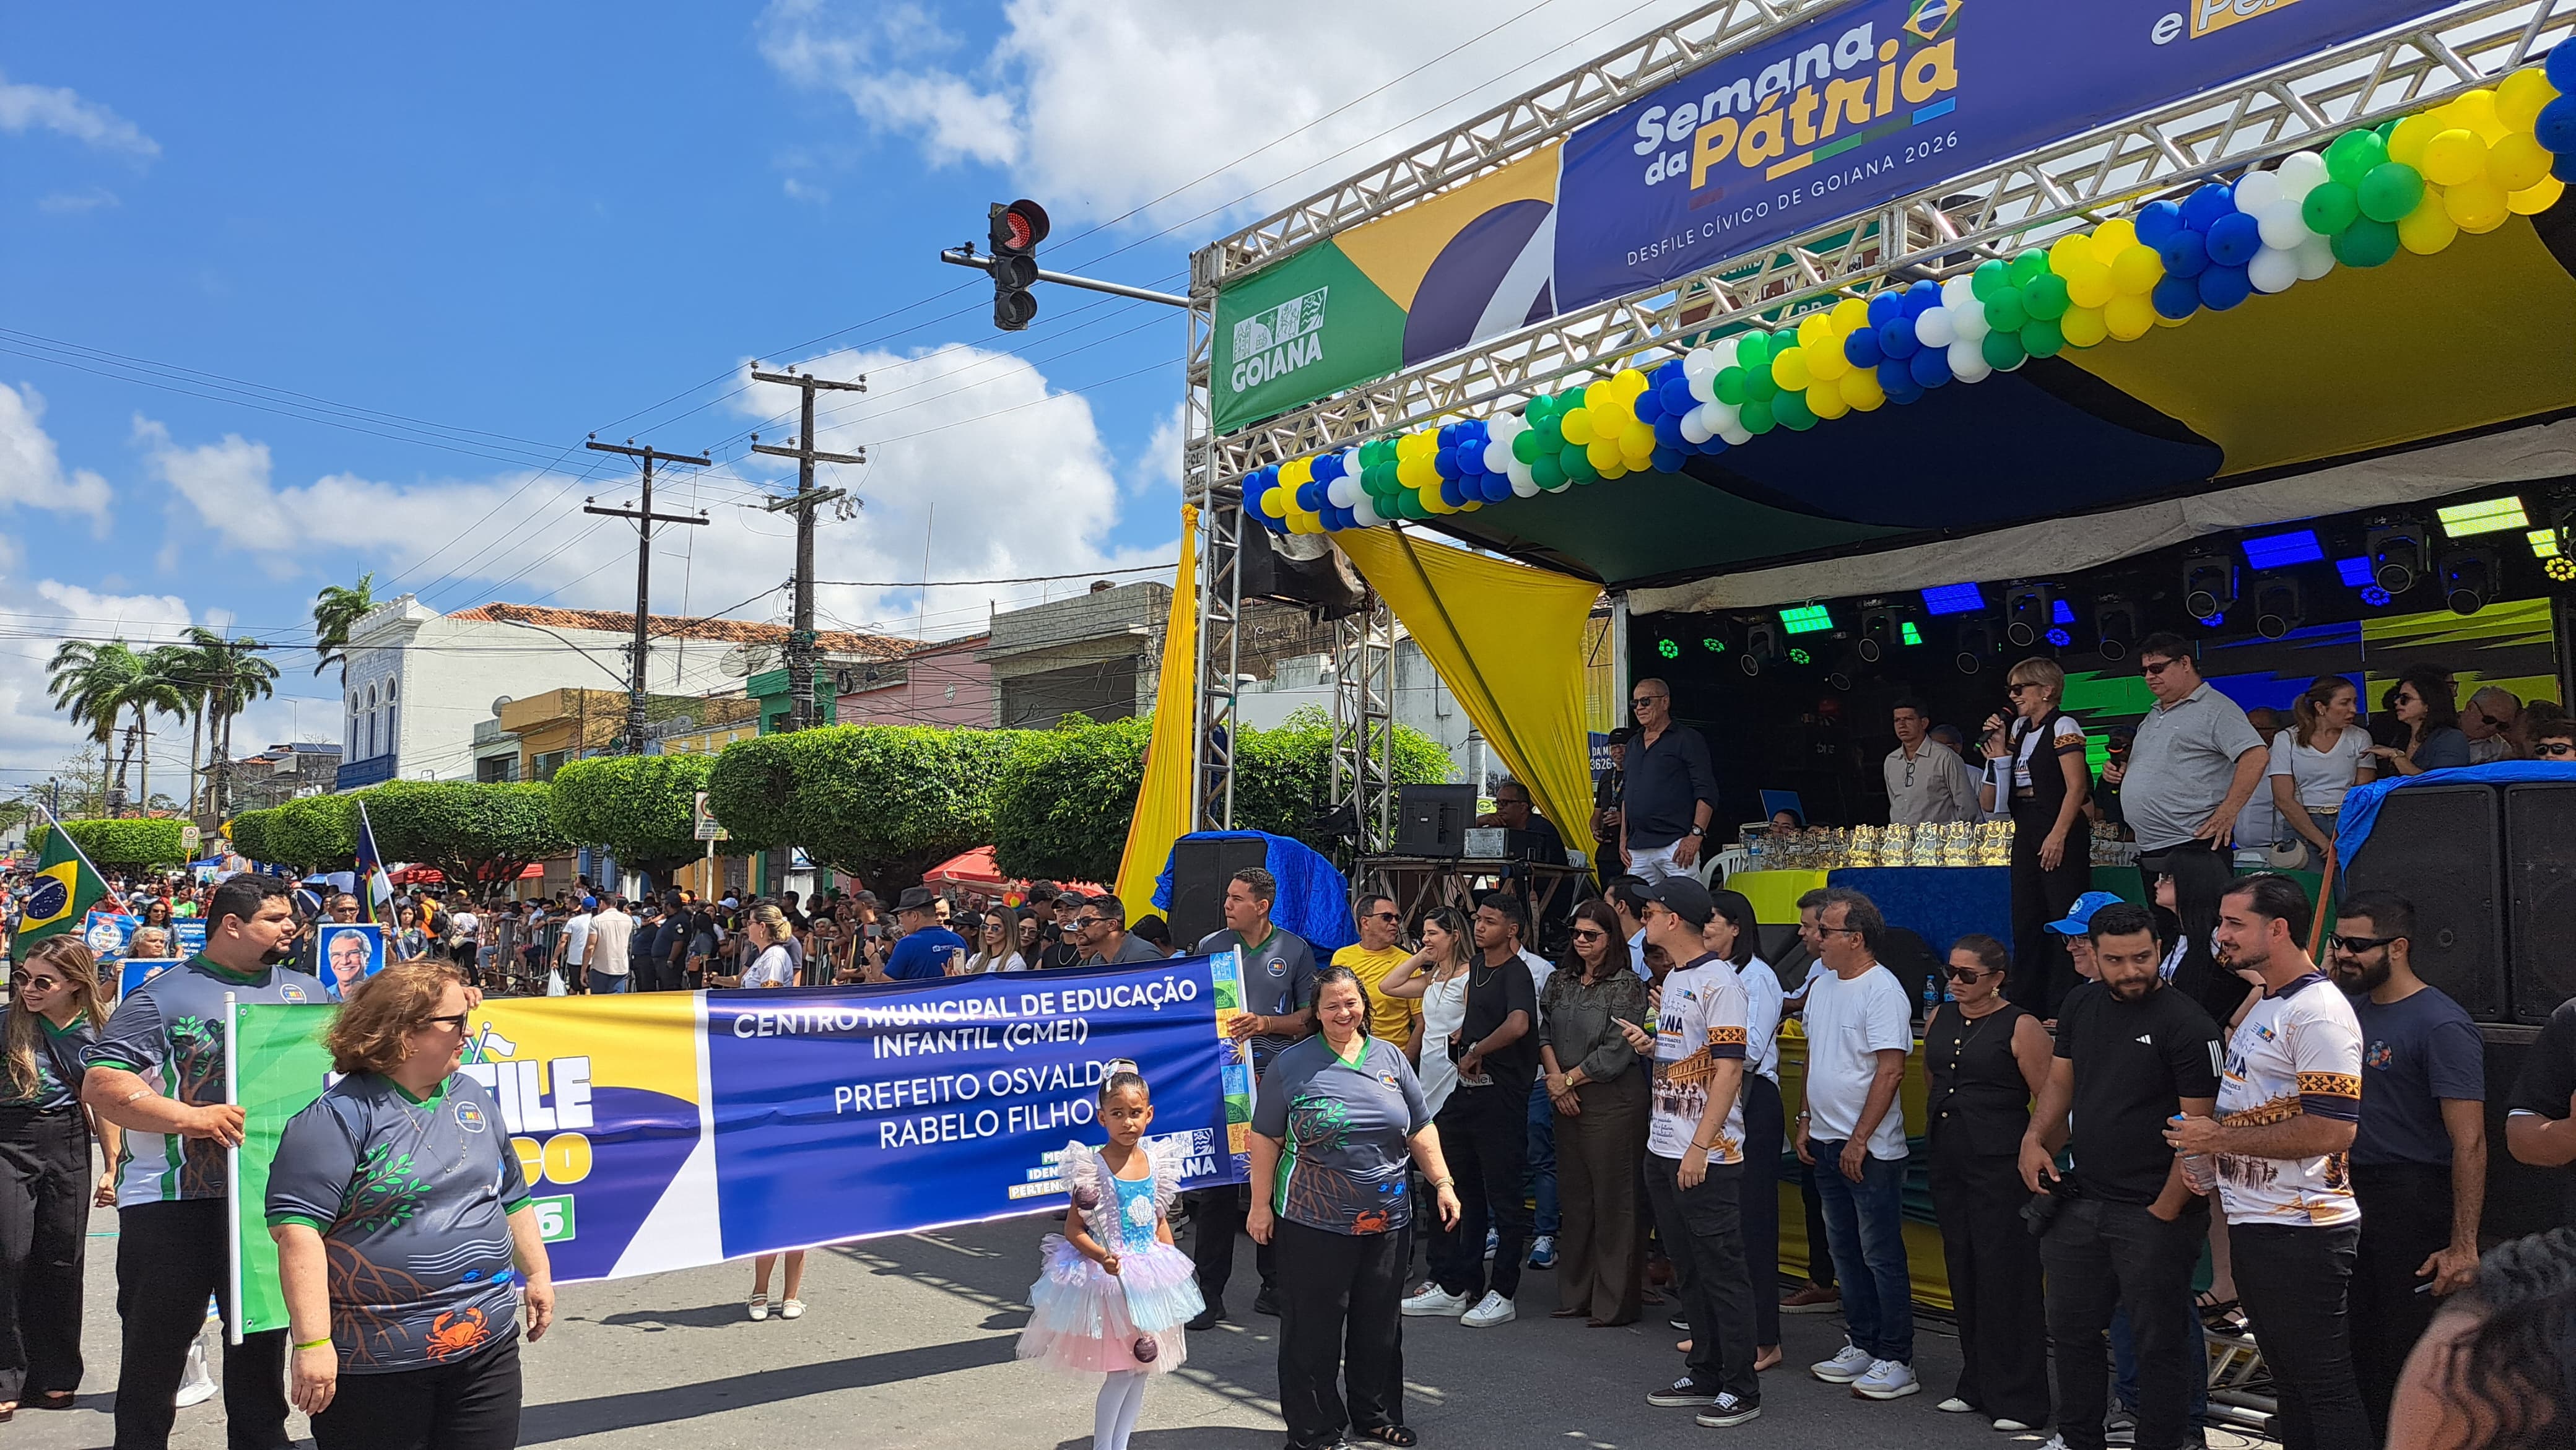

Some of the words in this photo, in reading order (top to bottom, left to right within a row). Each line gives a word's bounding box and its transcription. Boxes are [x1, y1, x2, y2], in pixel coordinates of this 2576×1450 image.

[2151, 12, 2183, 45] e
[1633, 20, 1874, 156] Semana
[1644, 149, 1688, 186] da
[1689, 37, 1958, 191] Pátria
[1627, 230, 1695, 266] DESFILE
[1702, 200, 1769, 238] CÍVICO
[1778, 189, 1802, 211] DE
[1811, 154, 1895, 198] GOIANA
[1905, 130, 1958, 164] 2026
[1232, 331, 1323, 393] GOIANA
[733, 1009, 859, 1038] CENTRO
[866, 996, 1017, 1028] MUNICIPAL
[1021, 992, 1056, 1017] DE
[1063, 976, 1198, 1012] EDUCAÇÃO
[873, 1026, 998, 1059] INFANTIL
[1003, 1016, 1089, 1052] (CMEI)
[835, 1073, 980, 1114] PREFEITO
[988, 1059, 1104, 1096] OSVALD
[880, 1109, 999, 1150] RABELO
[1008, 1098, 1094, 1134] FILHO
[1029, 1167, 1059, 1180] IDEN
